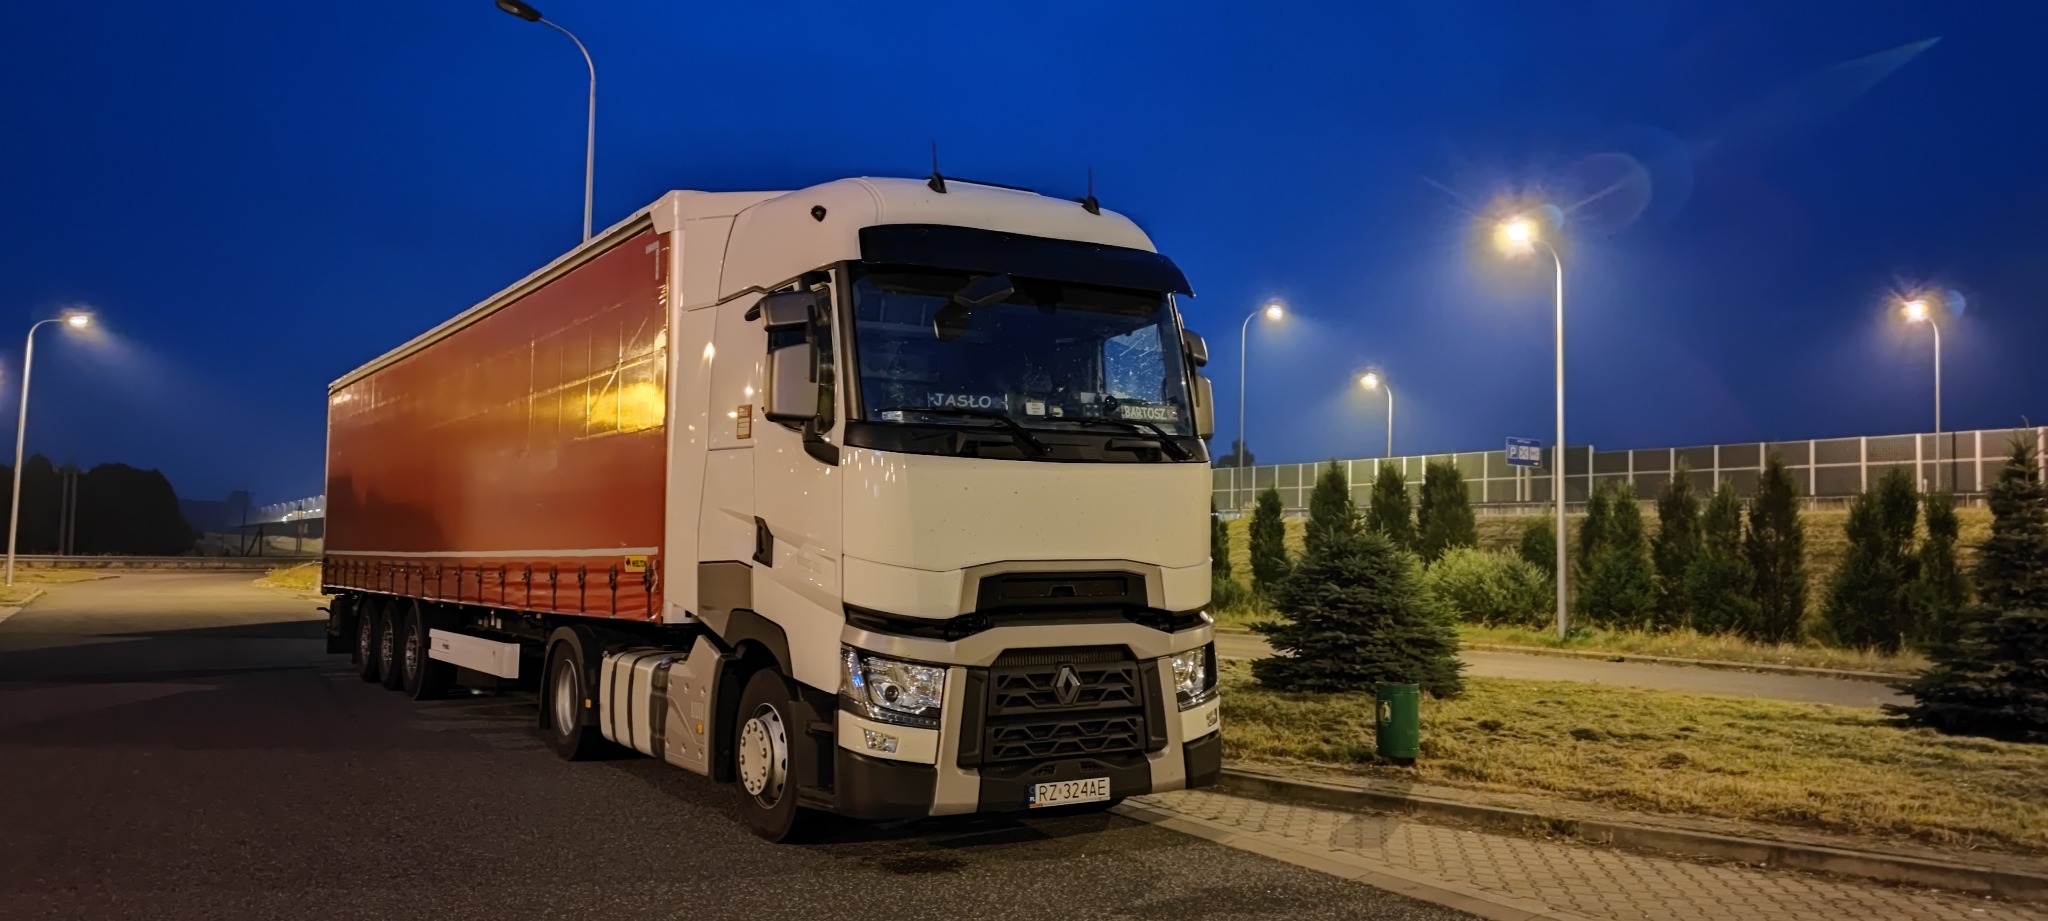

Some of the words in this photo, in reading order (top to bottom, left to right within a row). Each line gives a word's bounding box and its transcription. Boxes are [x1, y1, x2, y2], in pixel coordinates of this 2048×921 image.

[933, 393, 992, 408] JASŁO
[1124, 405, 1168, 420] BARTOSZ
[1039, 784, 1058, 801] RZ
[1063, 779, 1106, 799] 324AE
